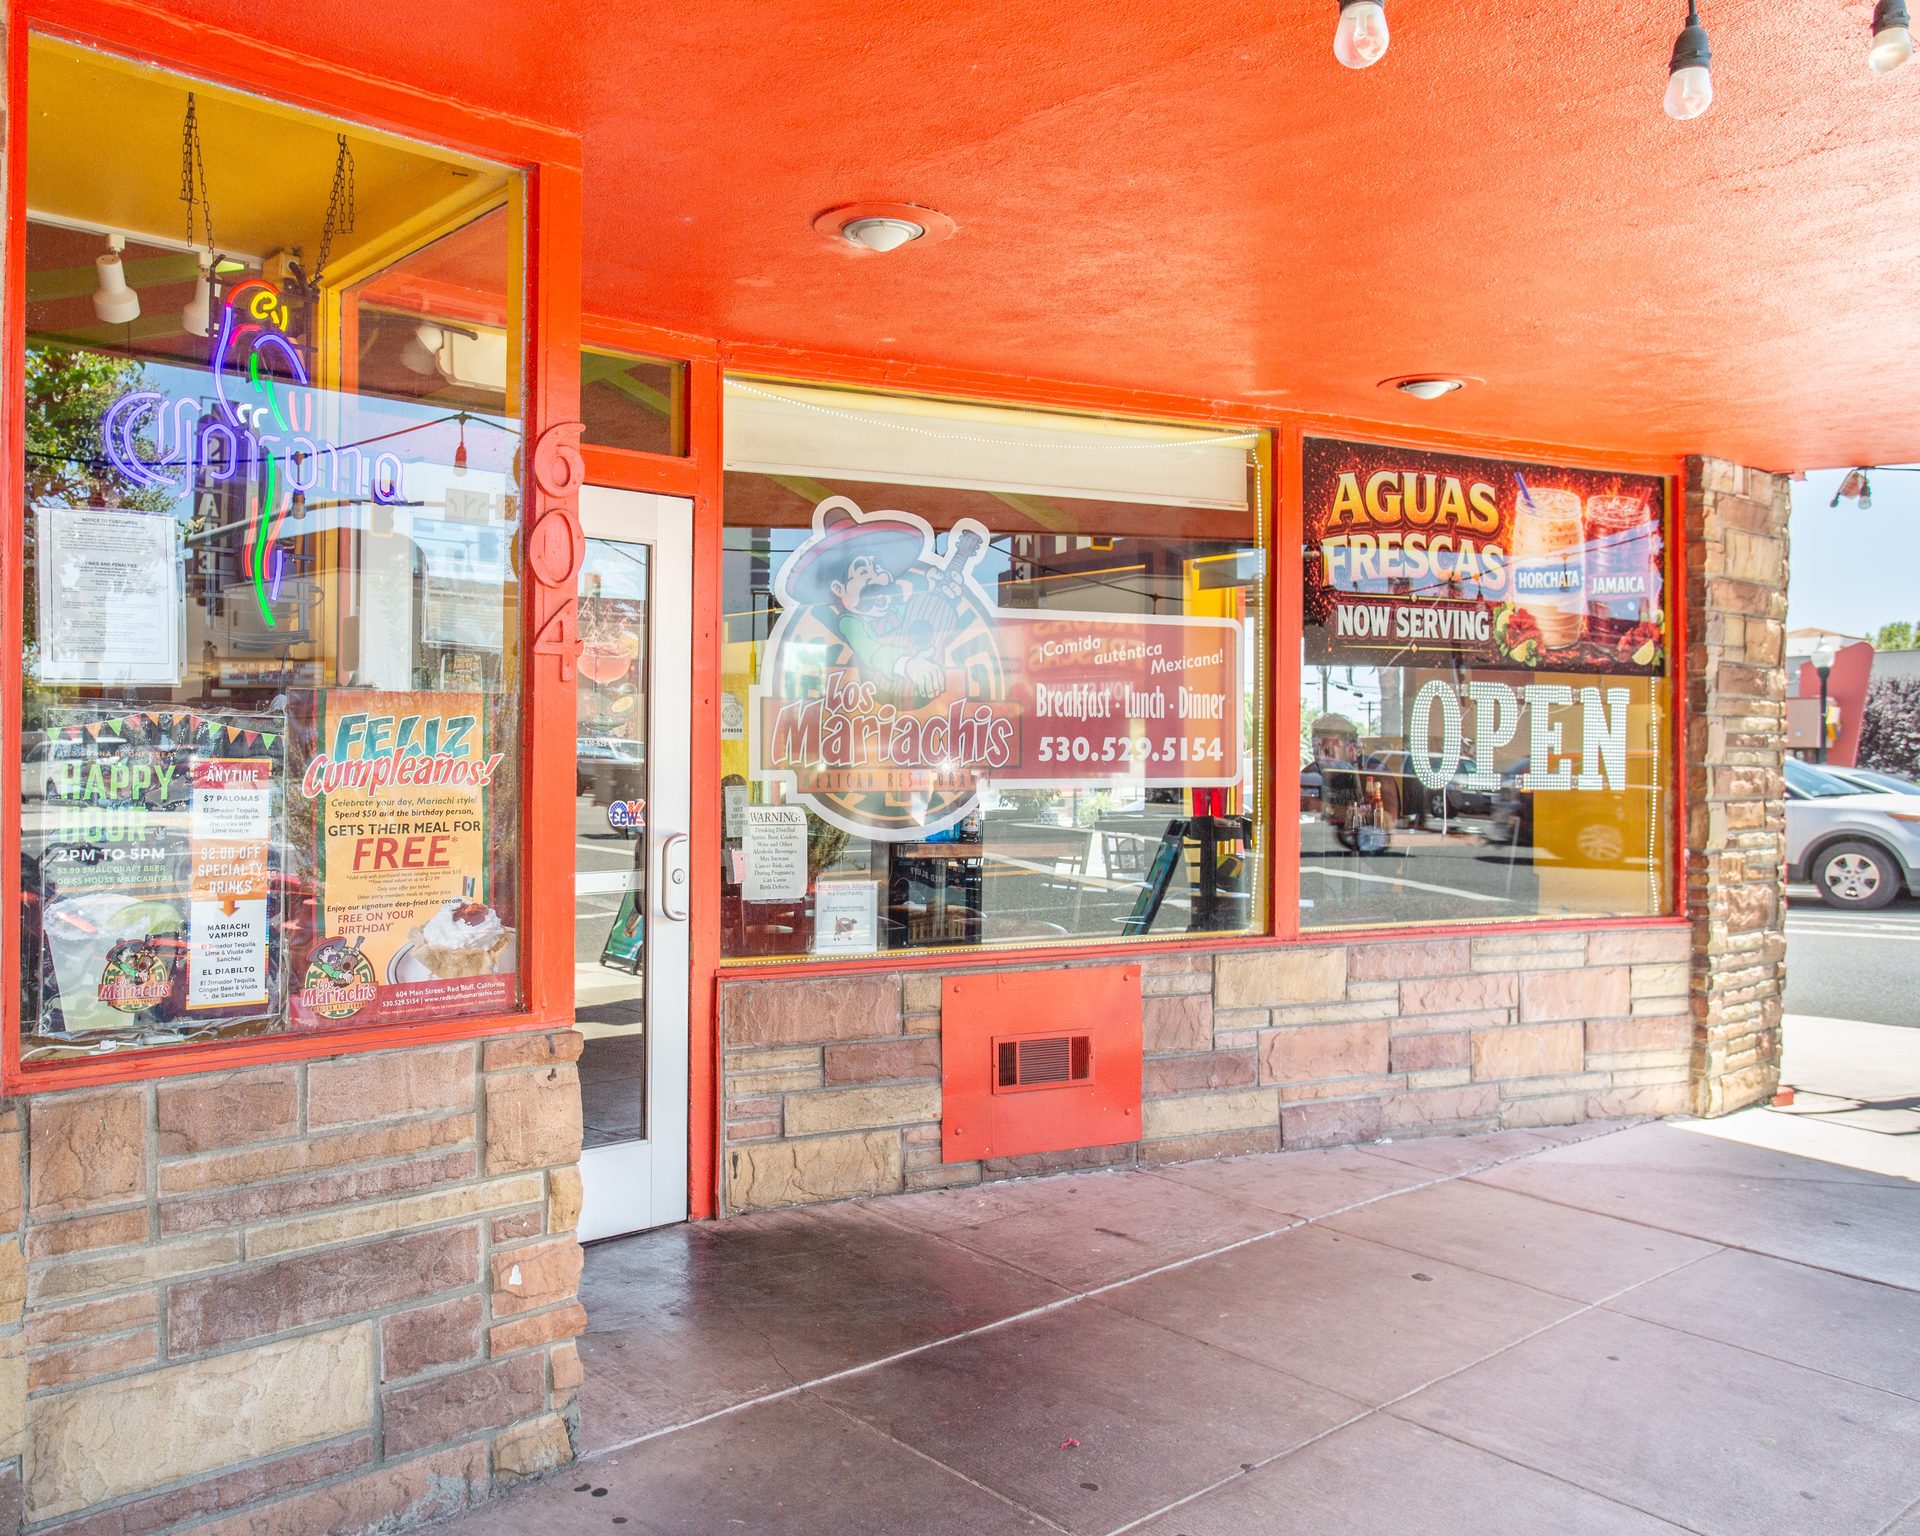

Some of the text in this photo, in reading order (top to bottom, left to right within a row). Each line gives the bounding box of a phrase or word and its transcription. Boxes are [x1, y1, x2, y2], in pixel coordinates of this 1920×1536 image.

[104, 391, 406, 503] Corona
[1327, 470, 1500, 533] AGUAS
[529, 422, 587, 682] 604
[1321, 532, 1506, 590] FRESCAS
[1518, 570, 1580, 589] HORCHATA
[1591, 576, 1645, 594] JAMAICA
[1337, 604, 1490, 641] NOW SERVING
[1039, 635, 1101, 662] ¡Comida
[1094, 643, 1163, 665] auténtica
[1151, 648, 1224, 675] Mexicana!
[825, 670, 877, 713] Los
[1036, 682, 1111, 722] Breakfast
[1125, 685, 1165, 719] Lunch
[1178, 686, 1226, 720] Dinner
[333, 713, 476, 763] FELIZ
[771, 697, 1014, 768] Mariachis
[1410, 680, 1630, 791] OPEN
[1038, 736, 1224, 762] 530.529.5154
[61, 762, 176, 800] HAPPY
[207, 769, 259, 782] ANYTIME
[302, 747, 504, 798] Cumpleaños!
[331, 795, 478, 809] Celebrate your day, Mariachi style!
[334, 808, 474, 819] Spend $50 and the birthday person,
[749, 811, 801, 823] WARNING:
[60, 806, 147, 843] HOUR
[328, 820, 481, 837] GETS THEIR MEAL FOR
[58, 847, 165, 861] 2PM TO 5PM
[201, 846, 261, 860] $2.00 OFF
[56, 866, 80, 875] $3.99
[82, 866, 111, 874] SMALL
[144, 864, 166, 872] BEER
[197, 861, 263, 876] SPECIALTY
[85, 876, 116, 884] HOUSE
[118, 875, 174, 883] MARGARITAS
[209, 879, 253, 895] DRINKS
[327, 905, 346, 913] Enjoy
[361, 901, 394, 911] signature
[395, 898, 428, 908] deep-fried
[429, 898, 440, 906] ice
[337, 909, 414, 924] FREE ON YOUR
[207, 923, 250, 931] MARIACHI
[208, 931, 249, 939] VAMPIRO
[215, 966, 255, 975] DIABILTO
[198, 986, 219, 994] Ginger
[318, 981, 334, 990] Los
[395, 989, 408, 998] 604
[409, 988, 425, 997] Main
[447, 985, 460, 993] Red
[476, 981, 505, 990] California
[220, 991, 246, 999] Sanchez
[302, 983, 377, 1007] Mariachis
